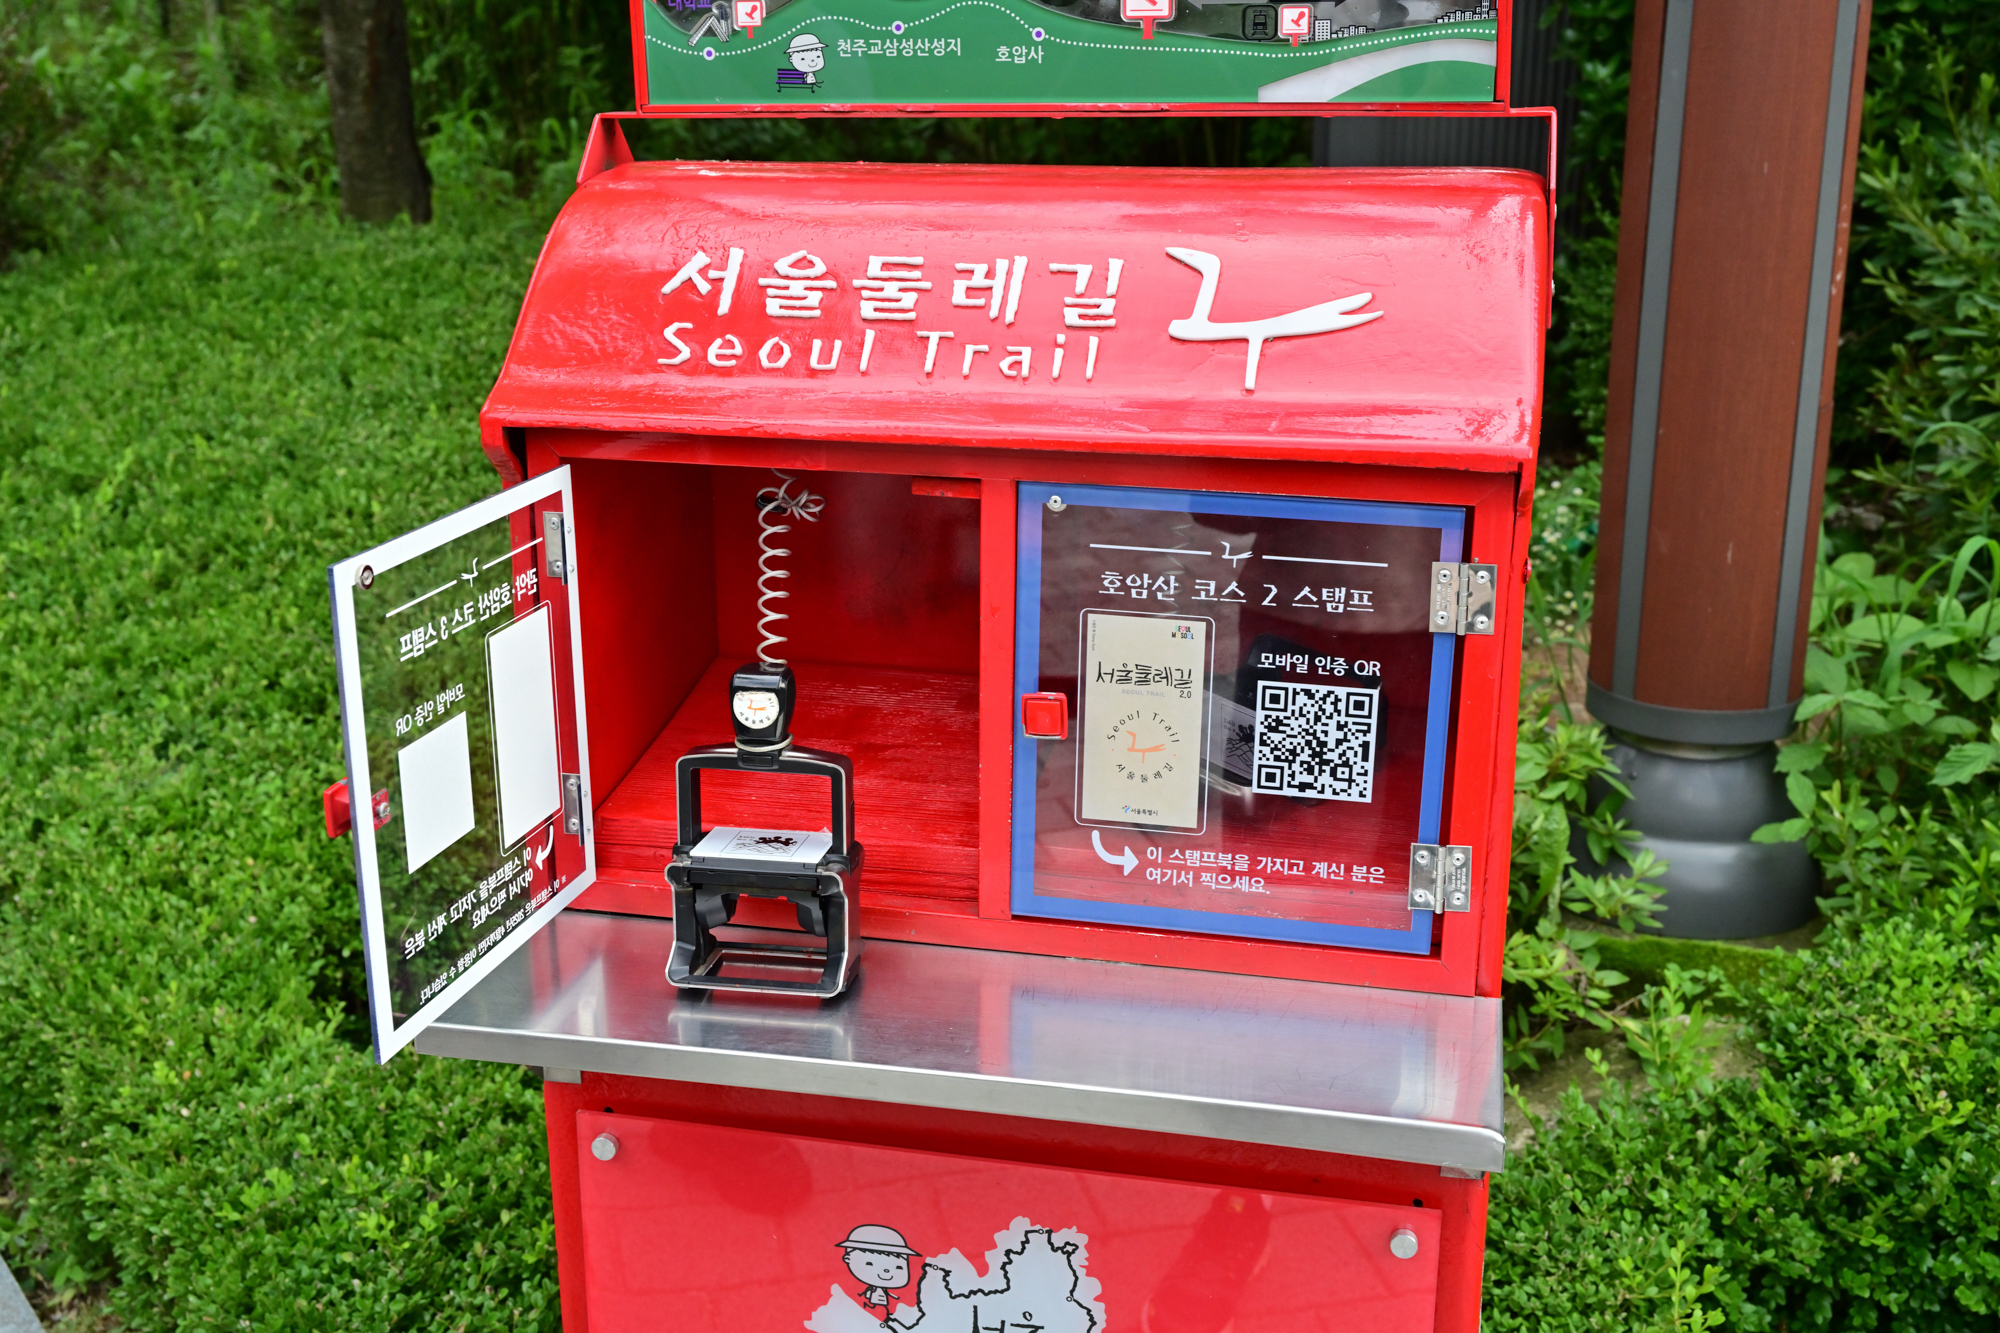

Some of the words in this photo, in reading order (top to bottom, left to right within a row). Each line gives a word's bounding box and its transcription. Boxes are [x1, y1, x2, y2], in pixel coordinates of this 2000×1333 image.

[836, 38, 962, 58] 천주교삼성산성지
[995, 46, 1044, 64] 호압사
[660, 247, 1125, 328] 서울둘레길
[657, 322, 876, 373] Seoul
[916, 330, 1099, 380] Trail
[1099, 571, 1179, 601] 호암산
[1191, 579, 1247, 603] 코스
[1261, 584, 1278, 607] 2
[1292, 585, 1375, 613] 스탬프
[1096, 661, 1192, 689] 서울둘레길
[1257, 652, 1309, 674] 모바일
[1314, 656, 1349, 677] 인증
[1354, 659, 1382, 677] QR
[1121, 688, 1144, 696] SEOUL
[1146, 690, 1166, 698] TRAIL
[1179, 690, 1192, 699] 2.0
[1106, 710, 1140, 741] Seoul
[1152, 711, 1180, 744] Trail
[1146, 846, 1163, 864] 이
[1168, 849, 1251, 871] 스탬프북을
[1256, 856, 1306, 876] 가지고
[1311, 861, 1345, 880] 계신
[1350, 865, 1386, 884] 분은
[1145, 867, 1194, 887] 여기서
[1200, 873, 1271, 894] 찍으세요.
